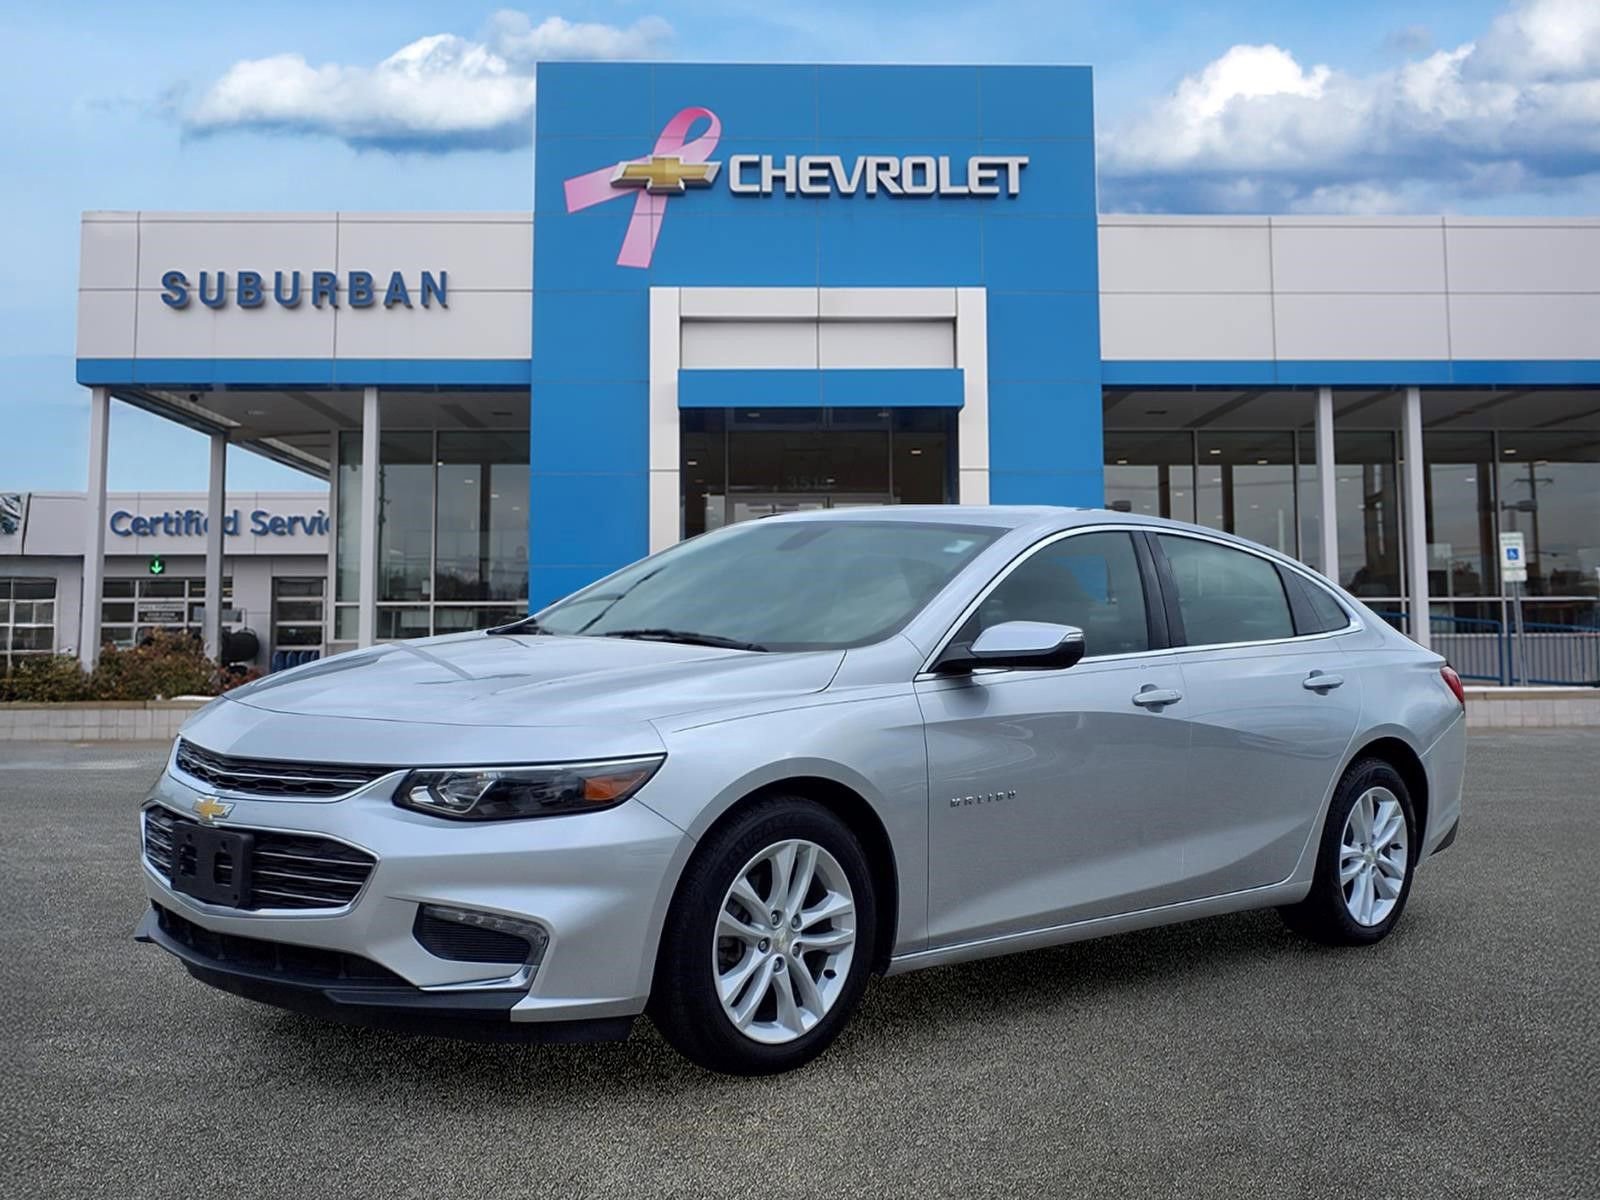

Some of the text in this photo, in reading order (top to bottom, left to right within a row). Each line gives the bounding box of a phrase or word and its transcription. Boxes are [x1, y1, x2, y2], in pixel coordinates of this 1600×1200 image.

[728, 154, 1029, 195] CHEVROLET
[161, 270, 449, 309] SUBURBAN
[110, 510, 240, 537] Certifid
